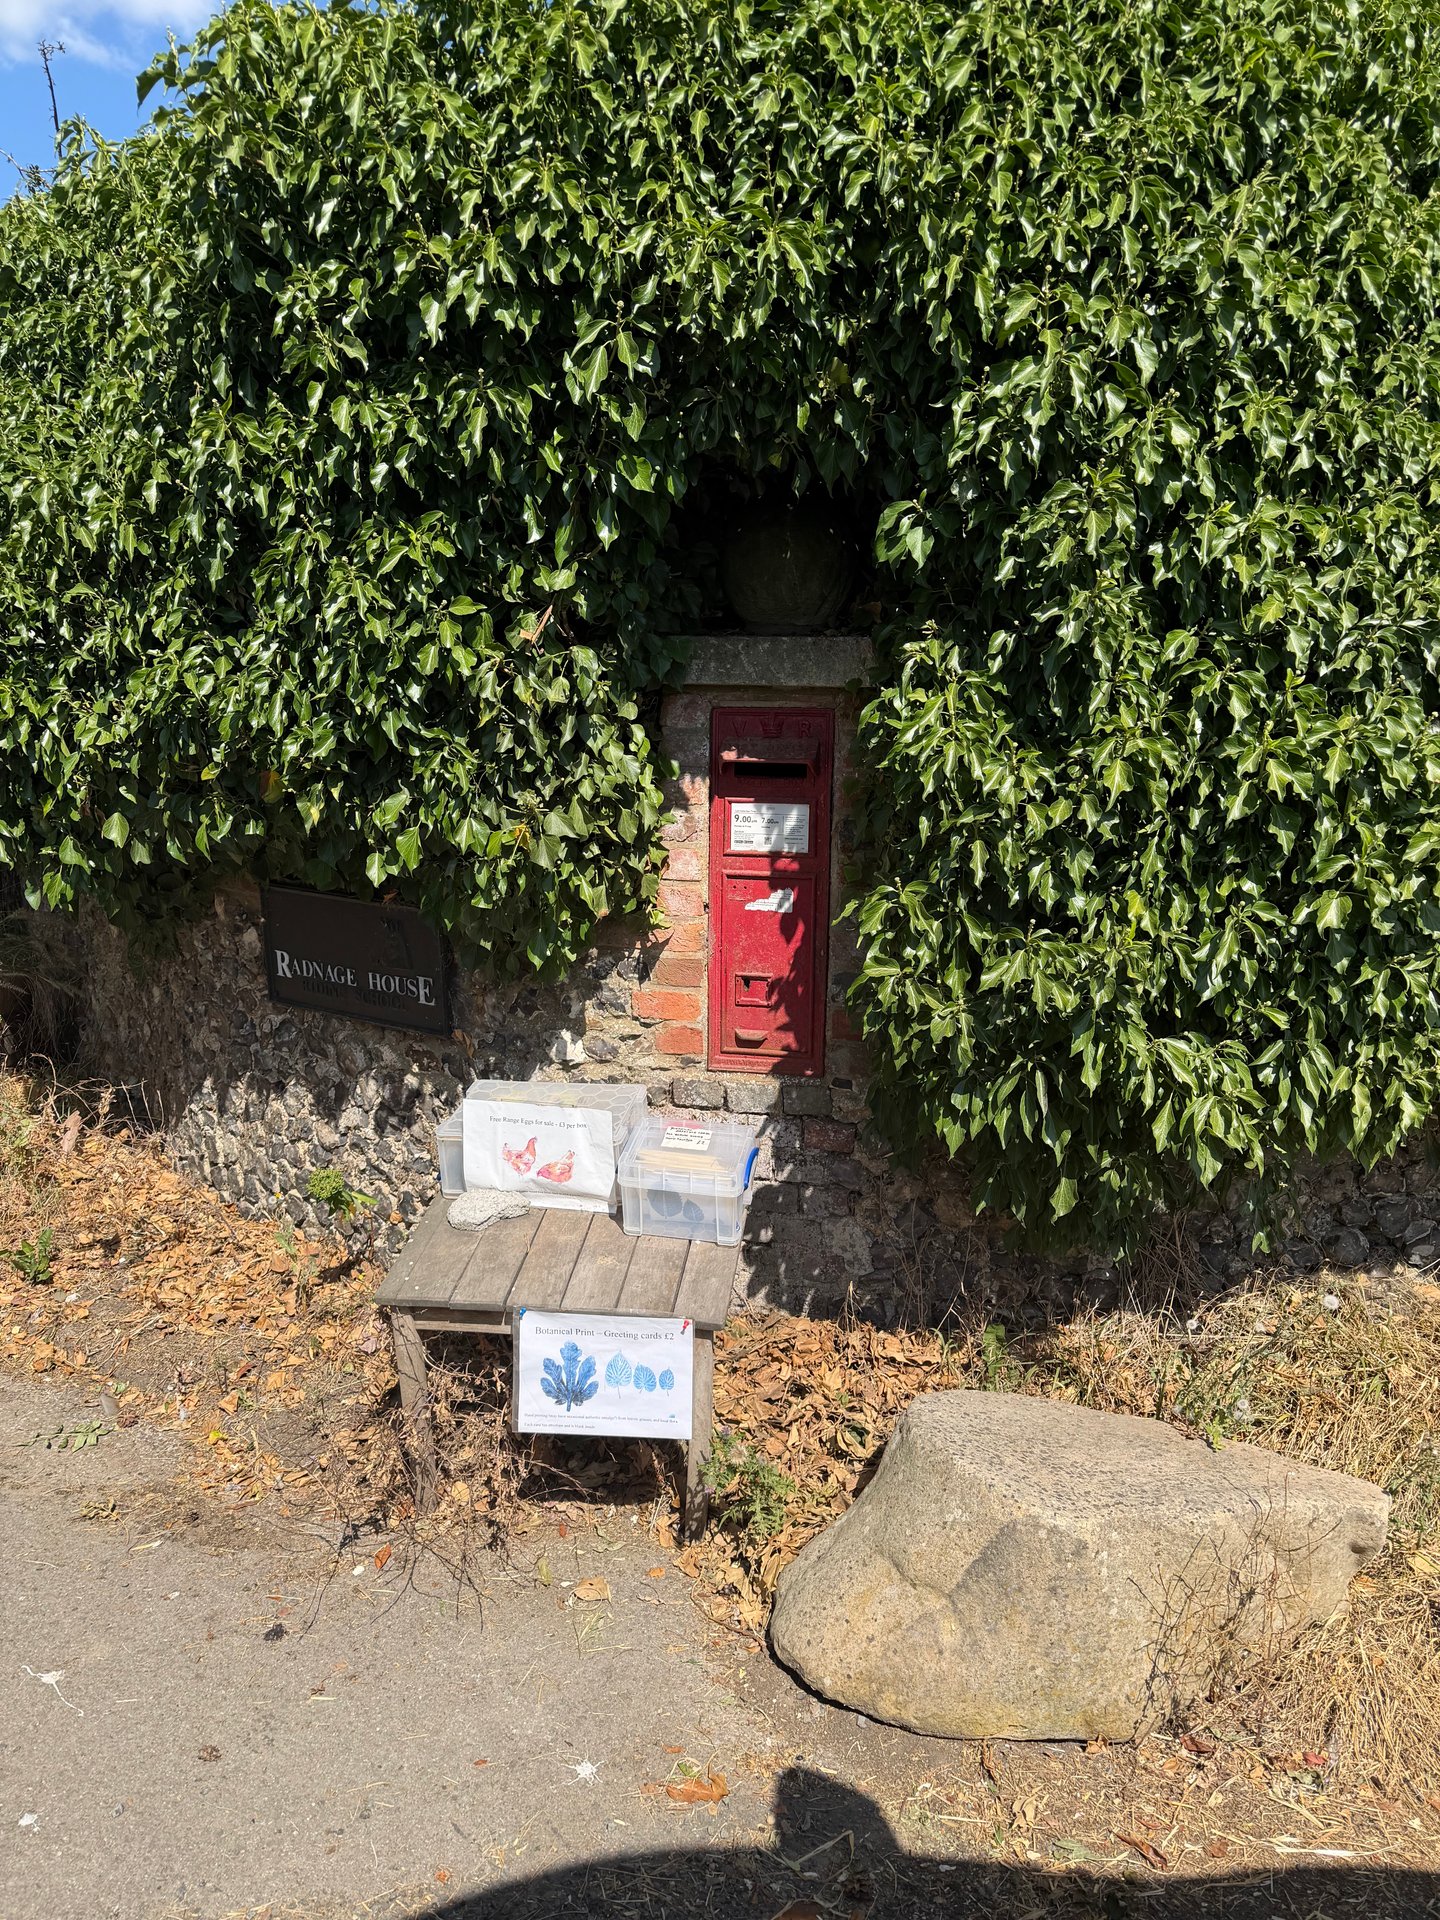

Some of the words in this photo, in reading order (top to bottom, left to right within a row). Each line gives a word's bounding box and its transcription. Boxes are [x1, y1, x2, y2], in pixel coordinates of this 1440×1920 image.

[489, 1115, 501, 1123] Free
[503, 1116, 519, 1124] Range
[521, 1118, 534, 1126] Eggs
[535, 1326, 572, 1336] Botanical
[575, 1328, 594, 1337] Print
[604, 1330, 639, 1340] Greeting
[640, 1332, 662, 1340] cards
[664, 1332, 674, 1340] £2
